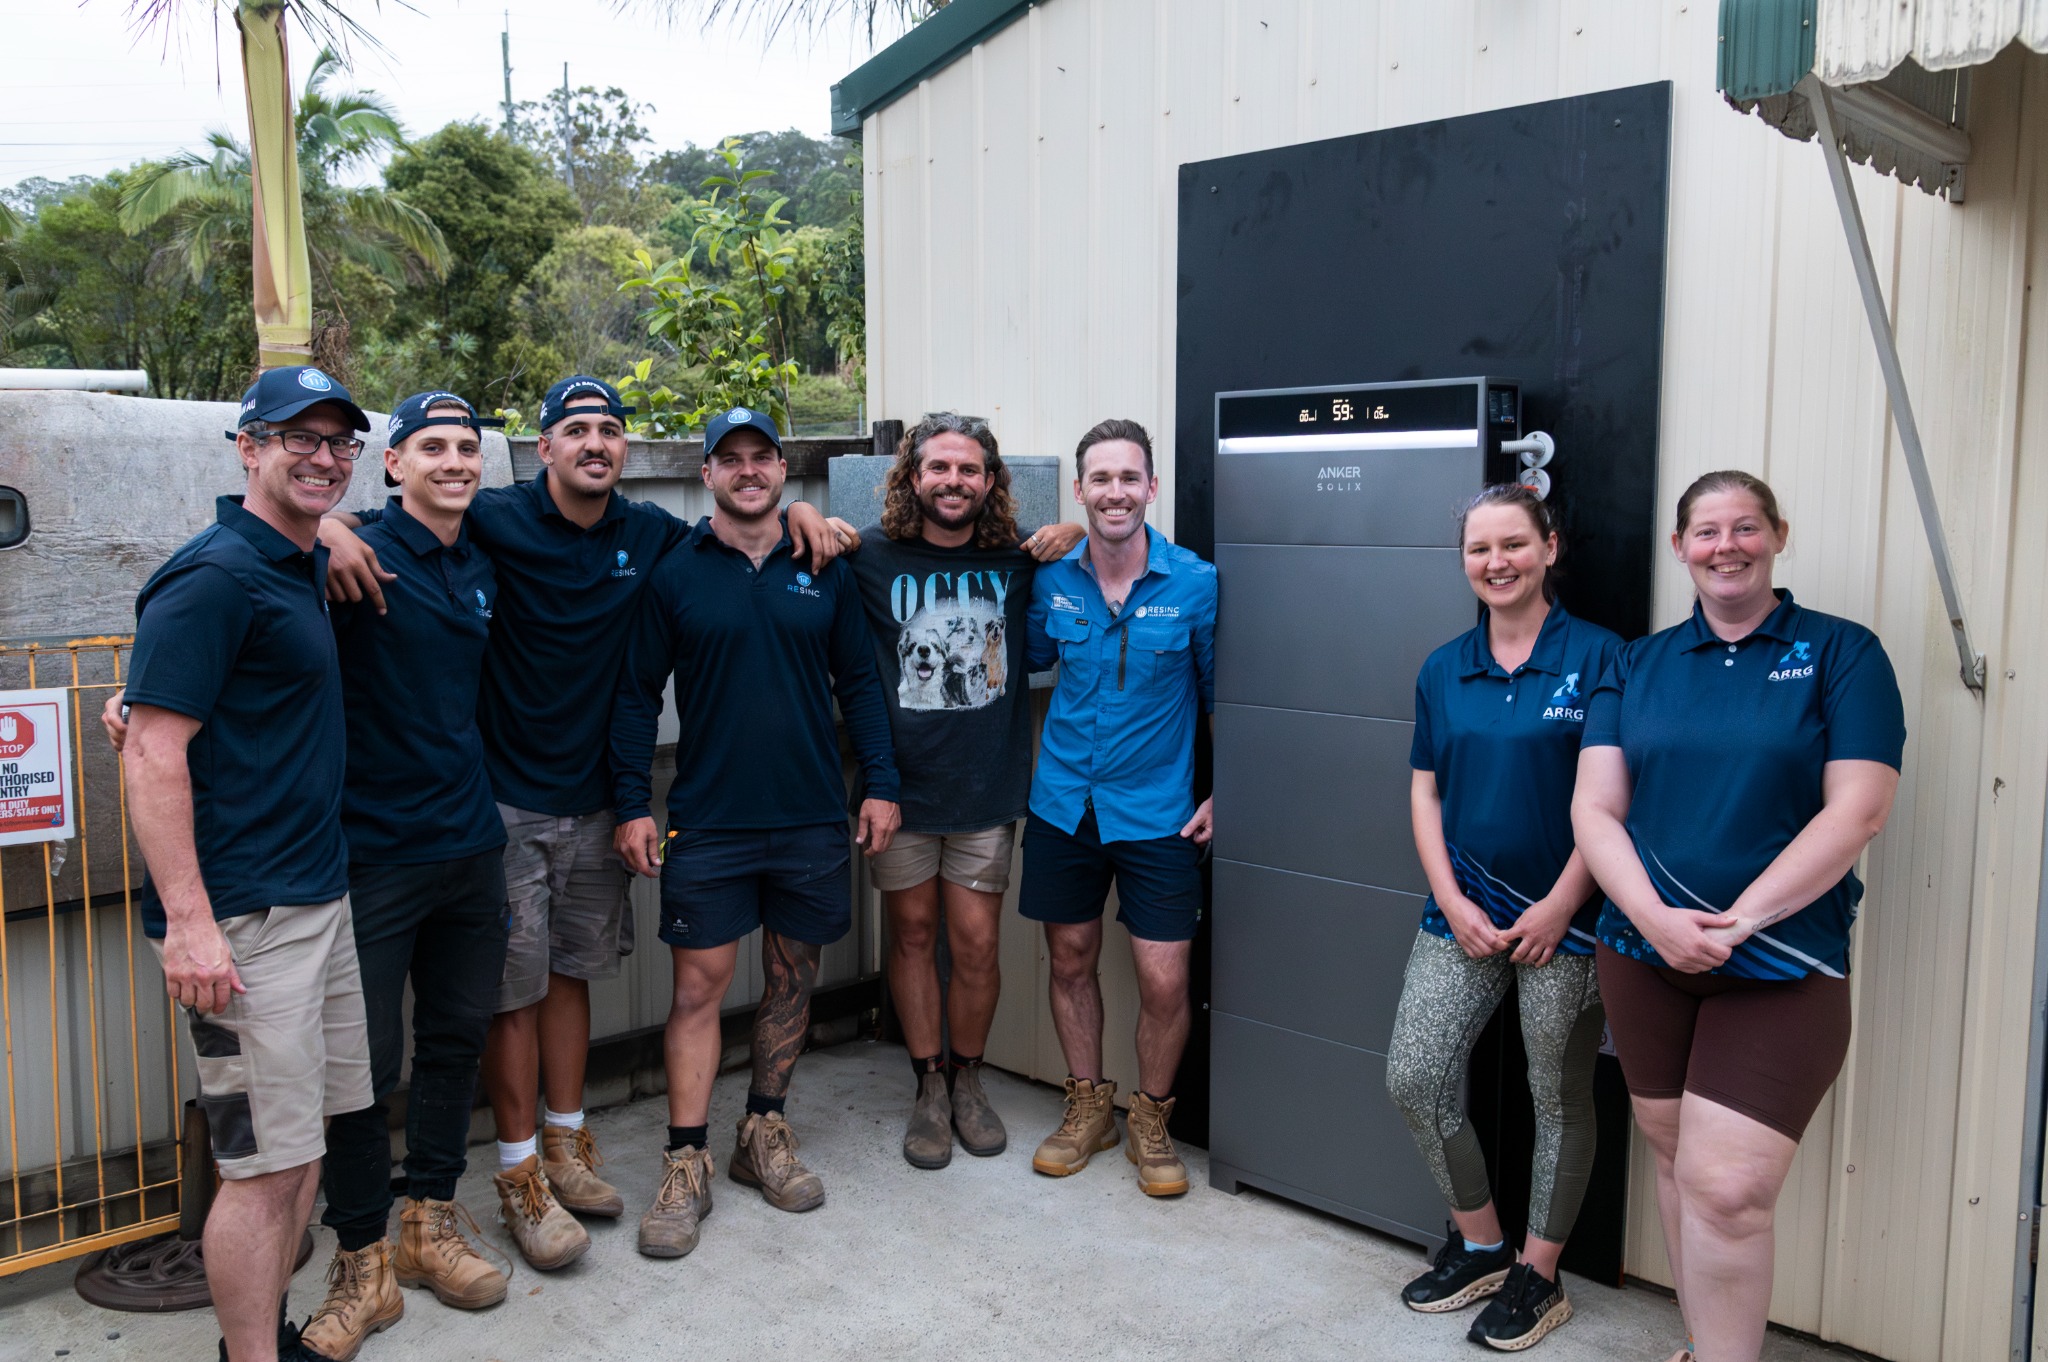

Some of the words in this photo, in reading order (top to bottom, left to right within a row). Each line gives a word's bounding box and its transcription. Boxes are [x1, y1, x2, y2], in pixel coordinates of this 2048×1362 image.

[1317, 466, 1361, 480] ANKER
[1316, 482, 1361, 491] SOLIX
[611, 567, 637, 577] RESINC
[787, 584, 820, 598] RESINC
[1147, 606, 1180, 614] RESINC
[1767, 664, 1814, 680] ARRG
[1542, 706, 1584, 720] ARRG
[2, 762, 19, 775] NO
[0, 771, 55, 787] THORISED
[8, 799, 30, 810] DUTY
[41, 804, 62, 815] ONLY
